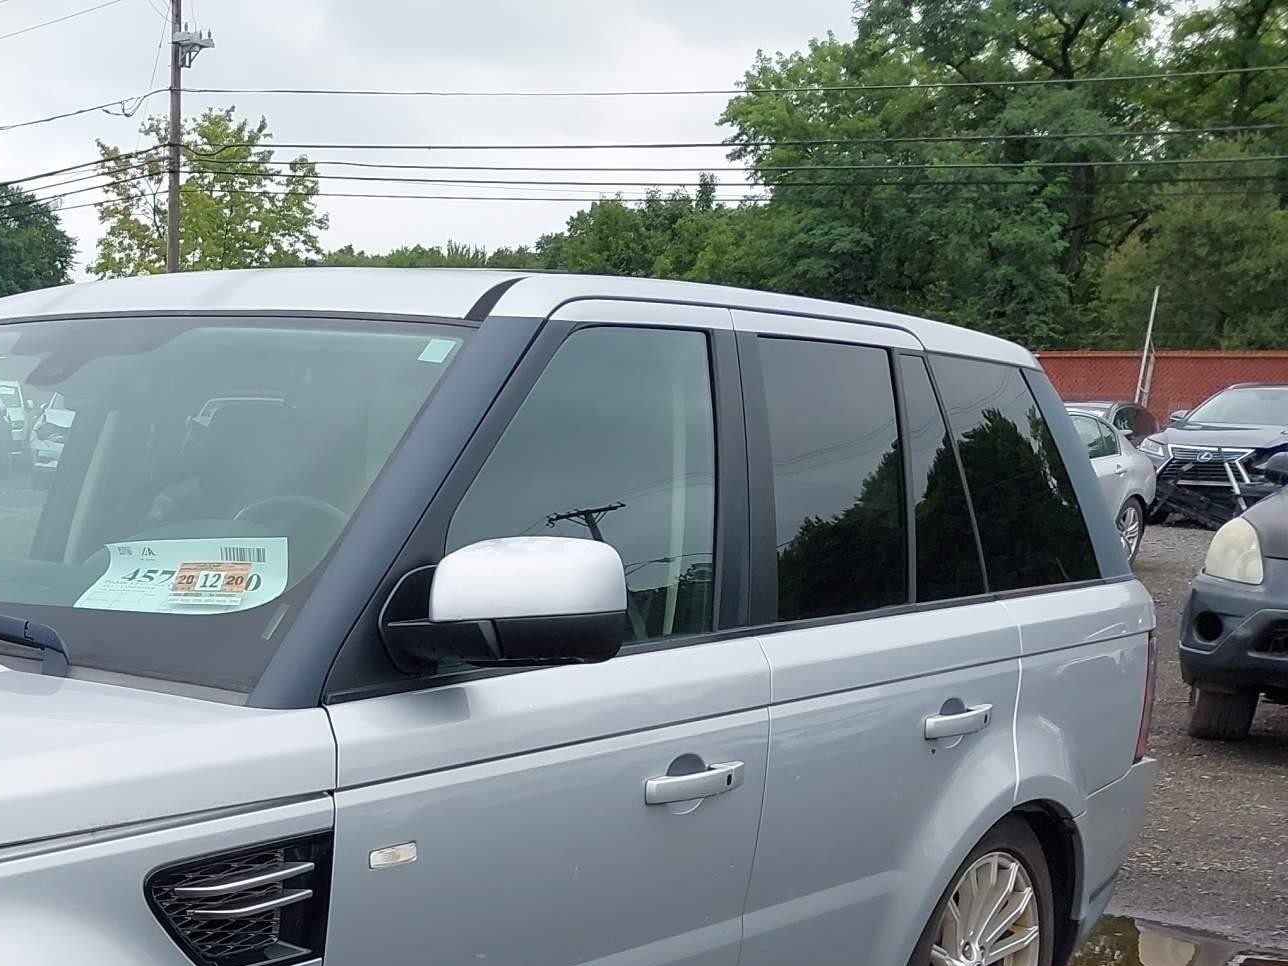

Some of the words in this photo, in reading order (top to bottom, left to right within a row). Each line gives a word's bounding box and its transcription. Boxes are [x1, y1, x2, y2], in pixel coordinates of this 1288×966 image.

[178, 574, 195, 585] 20
[199, 573, 222, 588] 12
[225, 575, 245, 586] 20
